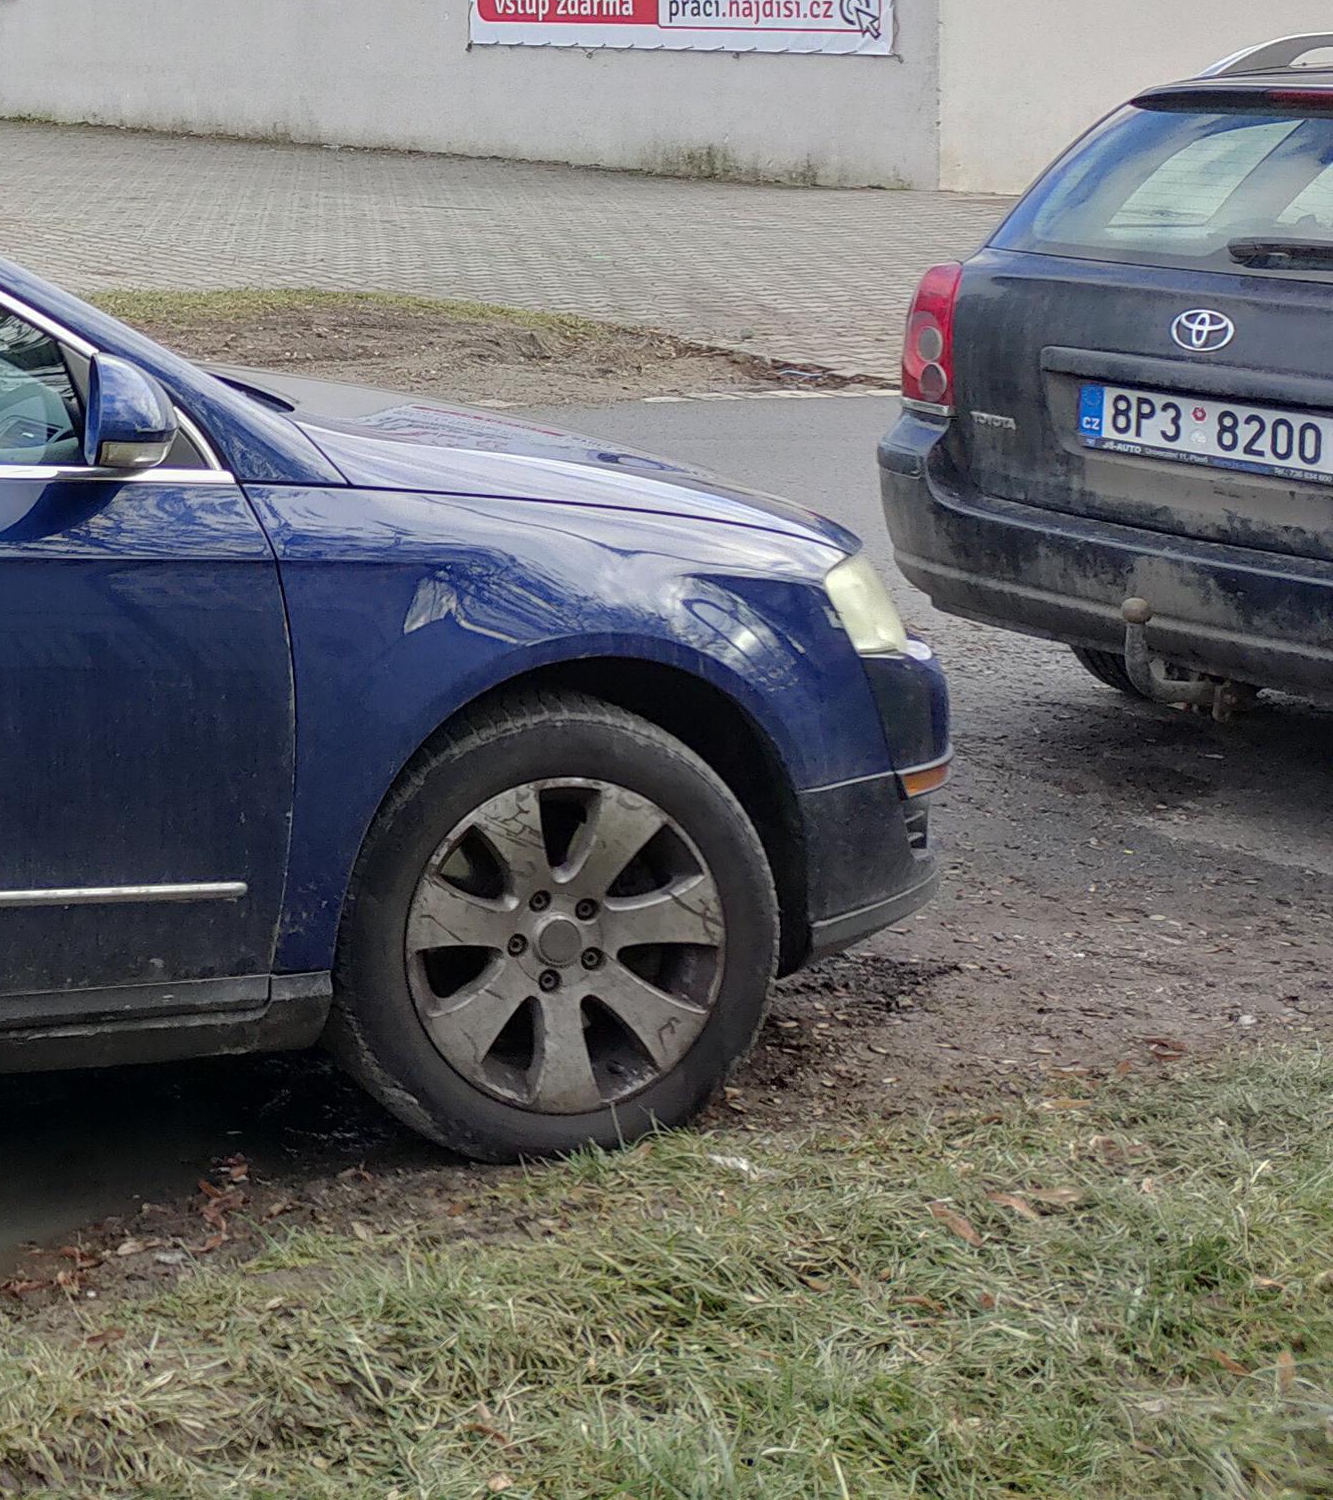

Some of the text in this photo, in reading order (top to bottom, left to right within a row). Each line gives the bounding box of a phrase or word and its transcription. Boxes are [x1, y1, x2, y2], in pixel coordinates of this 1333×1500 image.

[970, 411, 1016, 430] TOYOTA
[1082, 394, 1322, 466] CZ 8P3 8200
